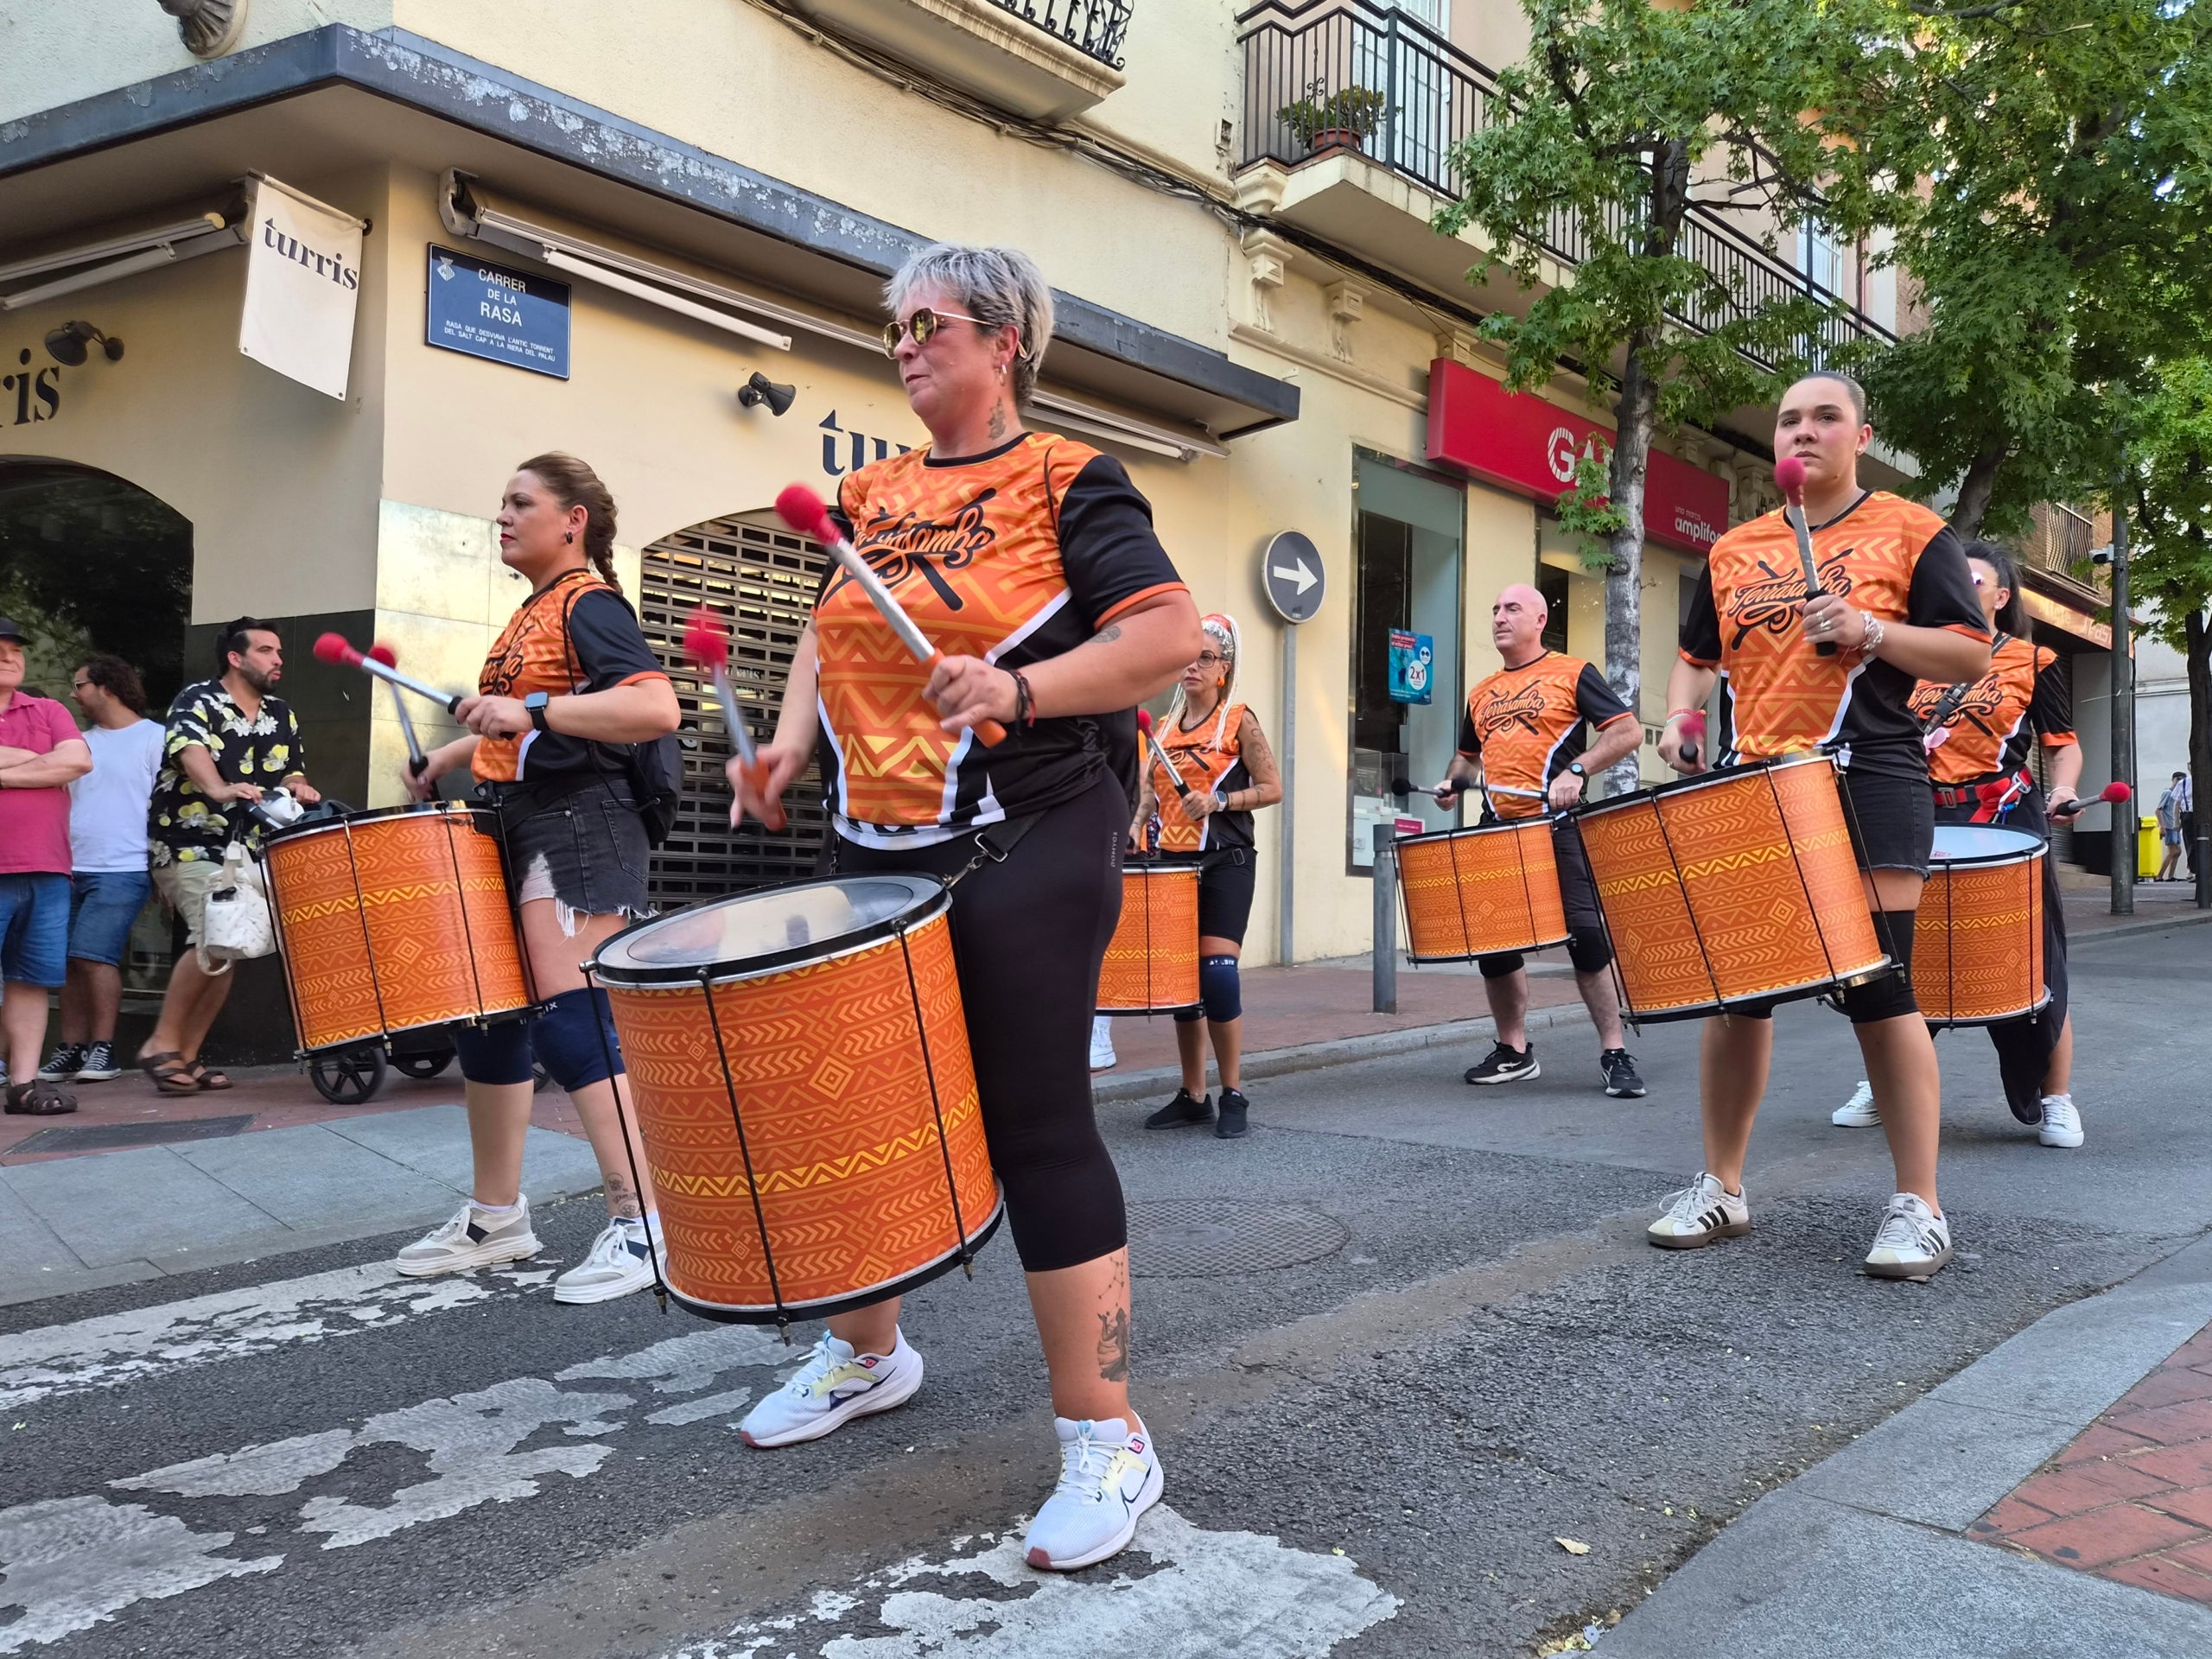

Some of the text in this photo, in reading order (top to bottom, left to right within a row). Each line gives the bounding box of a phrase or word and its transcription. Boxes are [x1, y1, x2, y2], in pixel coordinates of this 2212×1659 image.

[264, 218, 358, 290] turris
[478, 268, 526, 293] CARRER
[487, 289, 517, 305] DE LA
[480, 302, 523, 327] RASA
[444, 327, 455, 336] DEL
[458, 331, 473, 340] SALT
[475, 334, 487, 343] CAP
[506, 344, 523, 353] RIERA
[524, 348, 536, 357] DEL
[537, 353, 556, 362] PALAU
[446, 320, 554, 354] RASA QUE DESVIAVA L'ANTIC TORRENT
[1409, 666, 1425, 681] 2x1
[1479, 690, 1545, 728] Terrasamba
